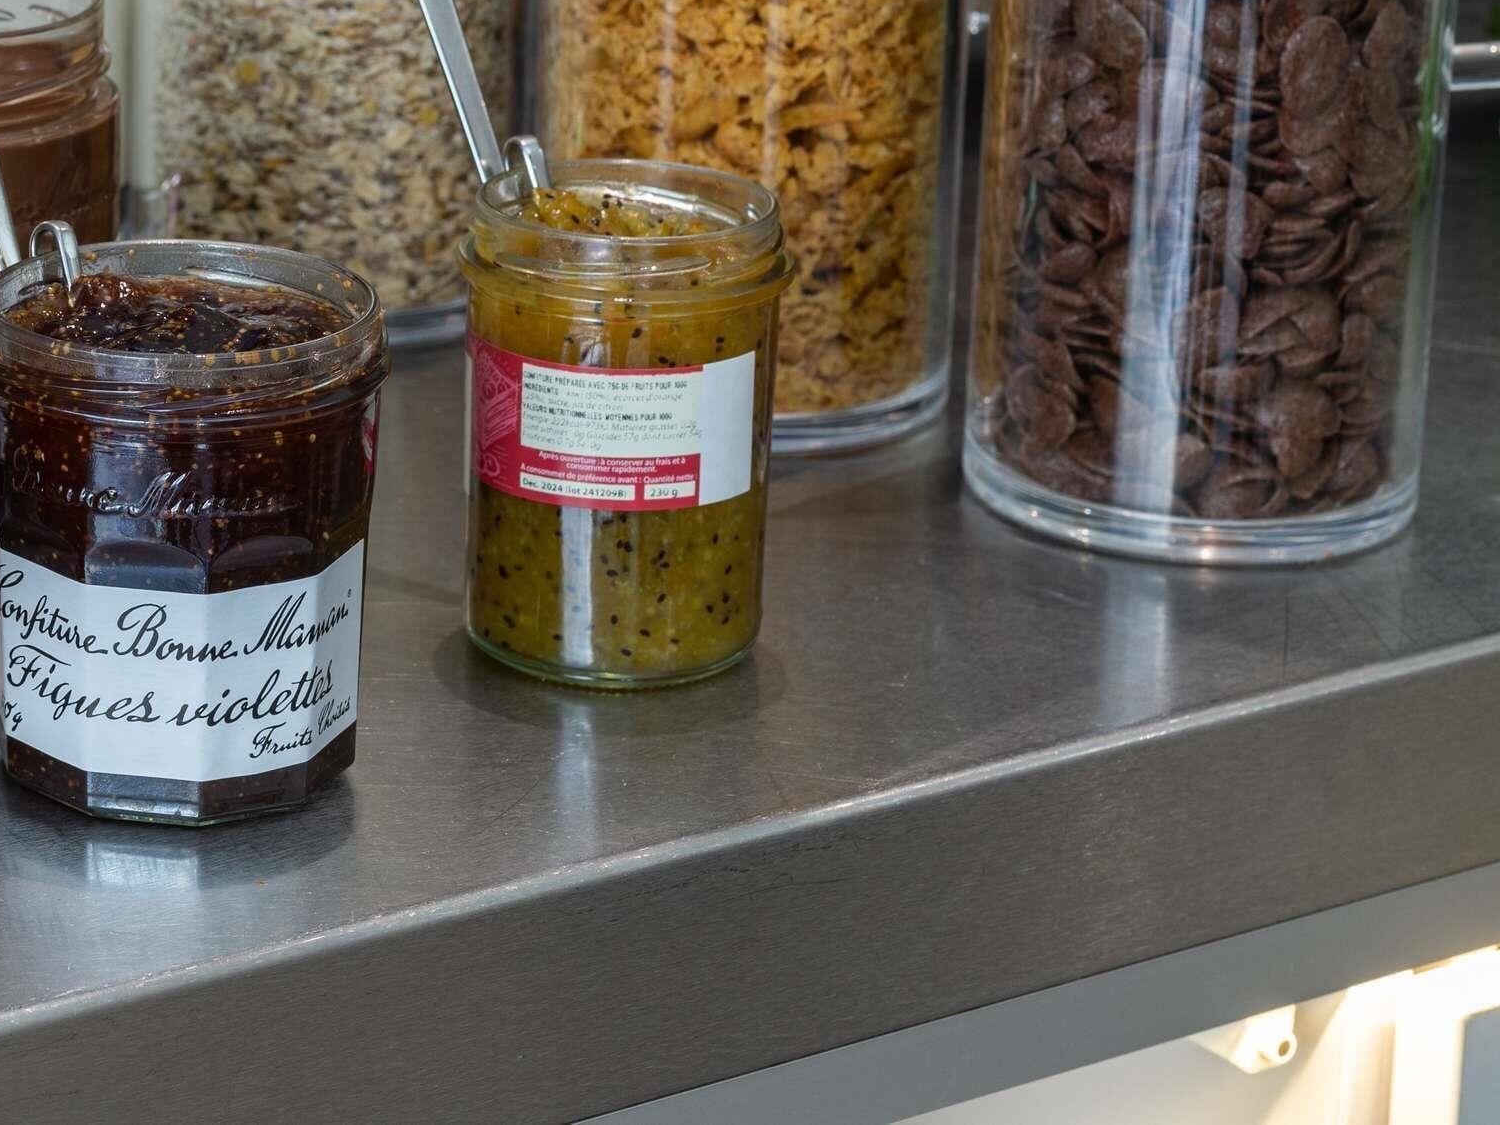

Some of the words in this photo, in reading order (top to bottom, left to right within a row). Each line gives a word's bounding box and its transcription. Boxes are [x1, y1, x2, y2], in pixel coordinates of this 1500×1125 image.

[538, 450, 559, 461] Après
[606, 458, 644, 467] conserver
[655, 457, 671, 465] frais
[566, 462, 610, 473] consommer
[526, 465, 566, 478] consommer
[566, 472, 576, 480] de
[577, 473, 616, 484] préférence
[617, 476, 638, 484] avant
[643, 475, 675, 484] Quantité
[541, 481, 563, 492] 2024
[113, 603, 238, 663] Bonne
[6, 644, 161, 723] Figues
[166, 659, 333, 727] violettes
[249, 722, 313, 759] Fruits
[317, 696, 351, 736] Choisis
